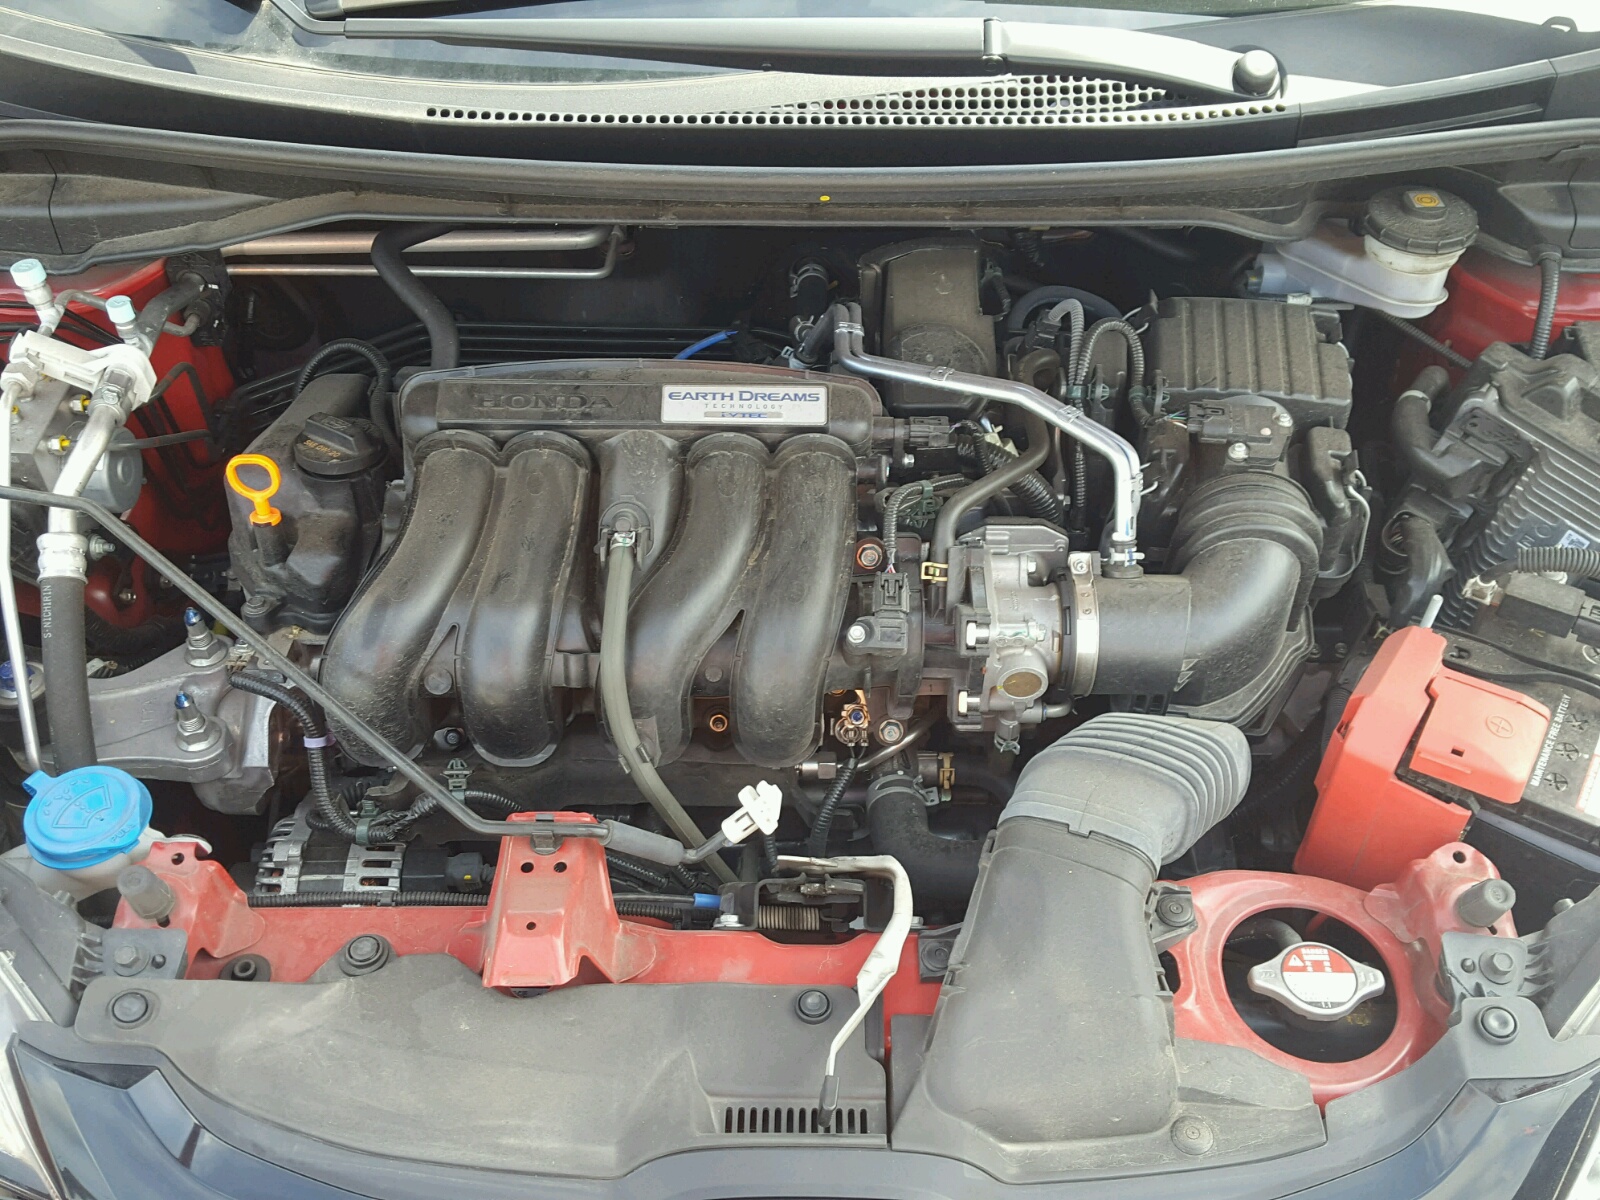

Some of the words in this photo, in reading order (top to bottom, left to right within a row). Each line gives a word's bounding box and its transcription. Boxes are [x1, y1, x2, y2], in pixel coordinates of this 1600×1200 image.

[473, 393, 617, 411] HONDA
[667, 391, 734, 401] EARTH
[738, 390, 820, 402] DREAMS
[1554, 693, 1572, 723] BATTERY
[1548, 721, 1562, 740] FREE
[1530, 739, 1555, 787] MAINTENANCE
